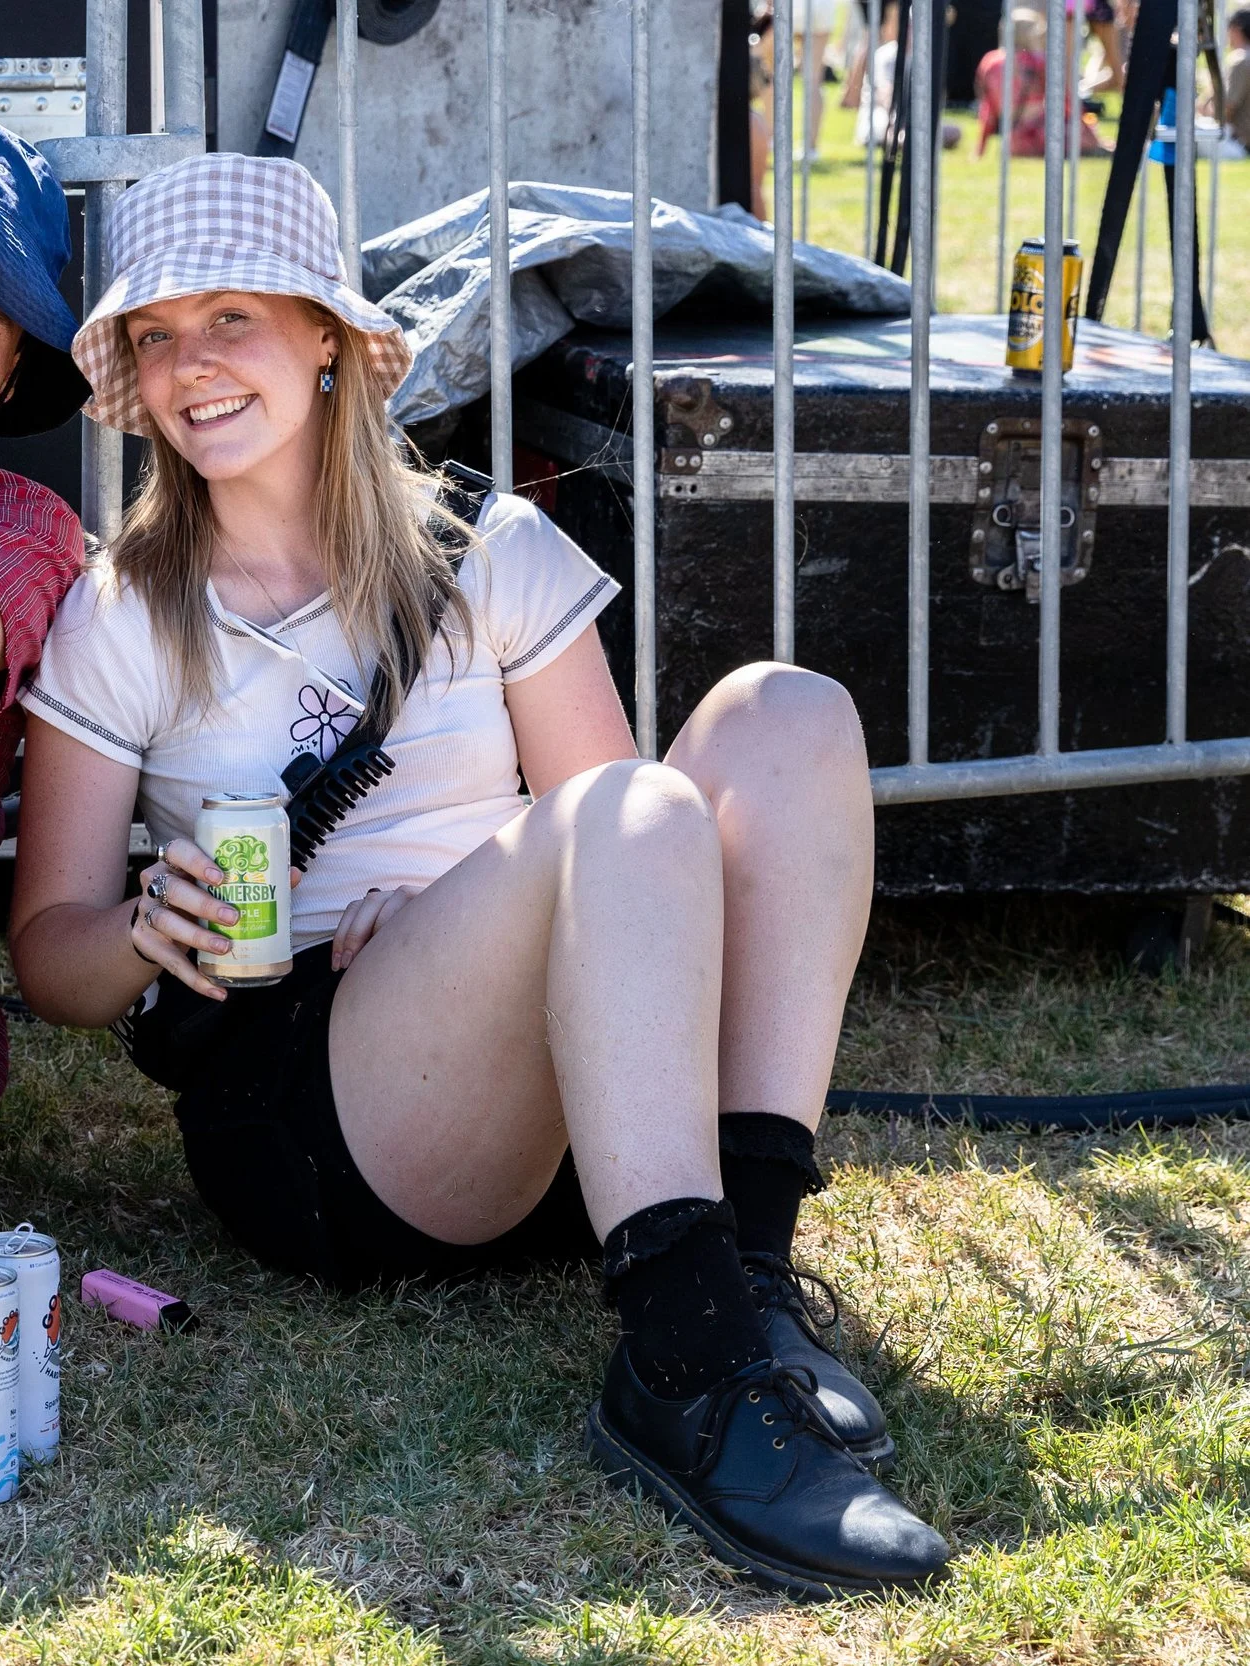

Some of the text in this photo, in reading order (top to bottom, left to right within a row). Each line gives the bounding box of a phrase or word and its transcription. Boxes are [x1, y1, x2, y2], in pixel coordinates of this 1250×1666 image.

[1011, 291, 1046, 316] OLO
[207, 884, 276, 901] SOMERSBY
[240, 908, 260, 918] PLE
[45, 1367, 59, 1379] HAR
